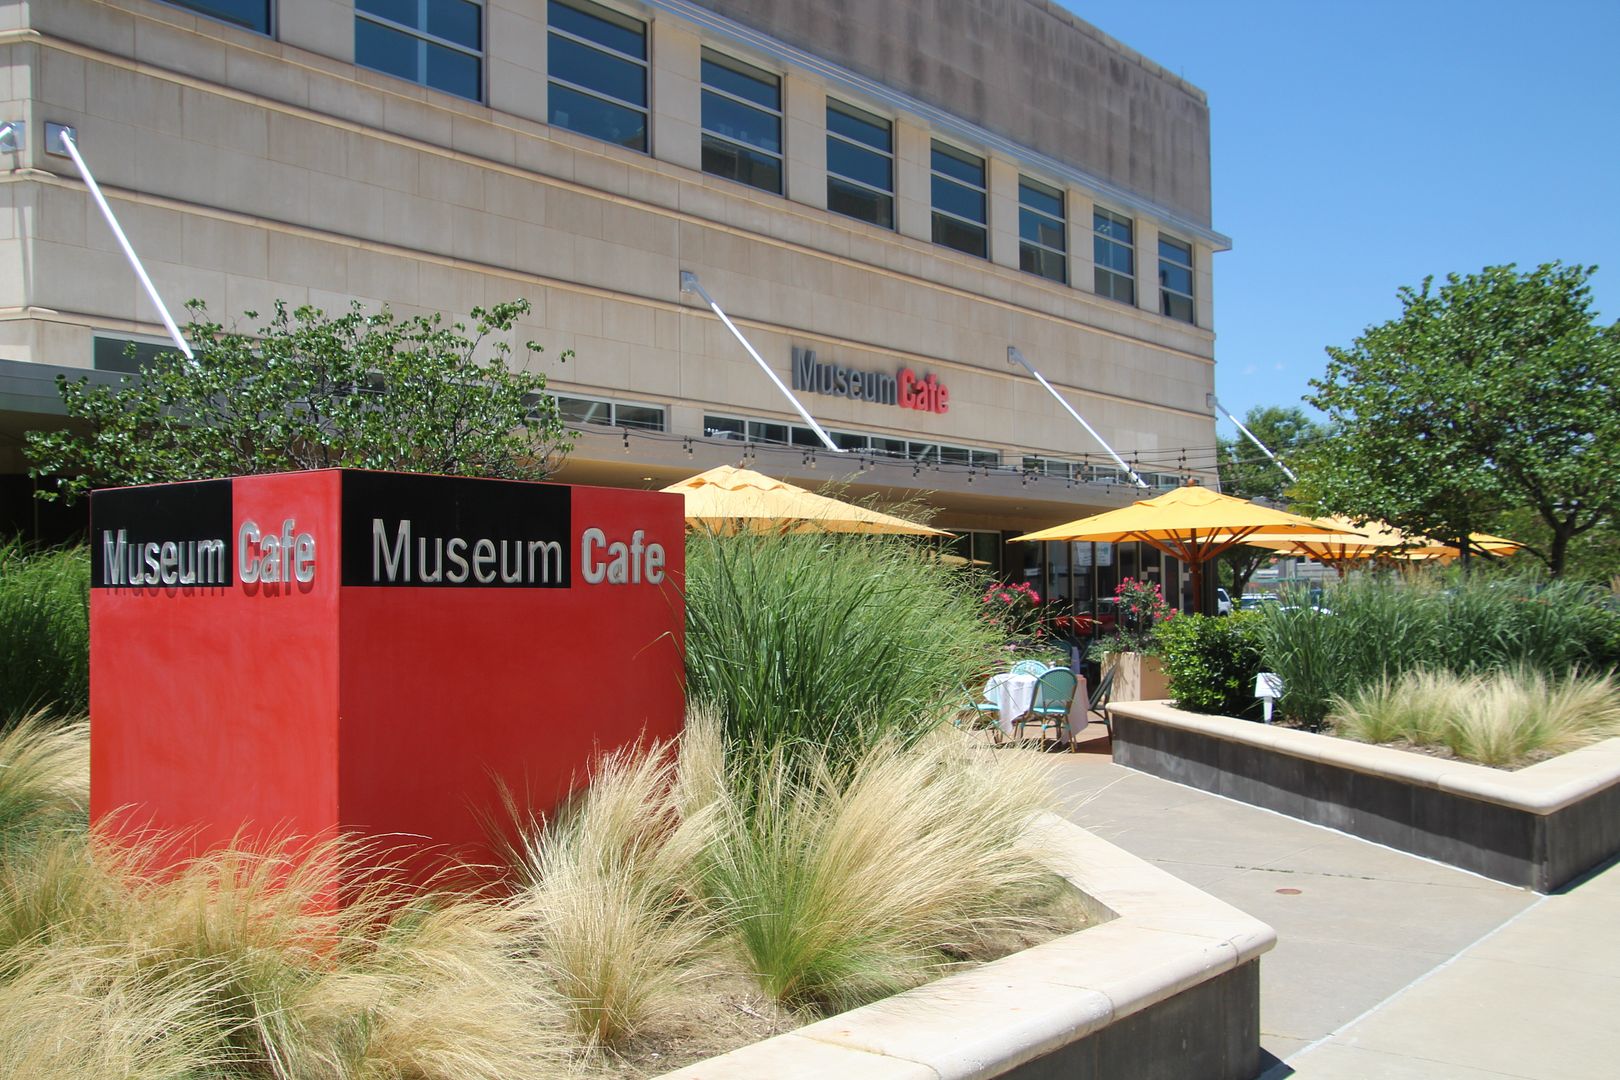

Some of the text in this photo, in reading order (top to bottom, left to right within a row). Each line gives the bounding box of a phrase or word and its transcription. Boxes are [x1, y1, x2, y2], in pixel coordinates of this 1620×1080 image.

[792, 347, 949, 414] Museum Cafe
[103, 518, 316, 585] Museum Cafe
[372, 518, 665, 585] Museum Cafe
